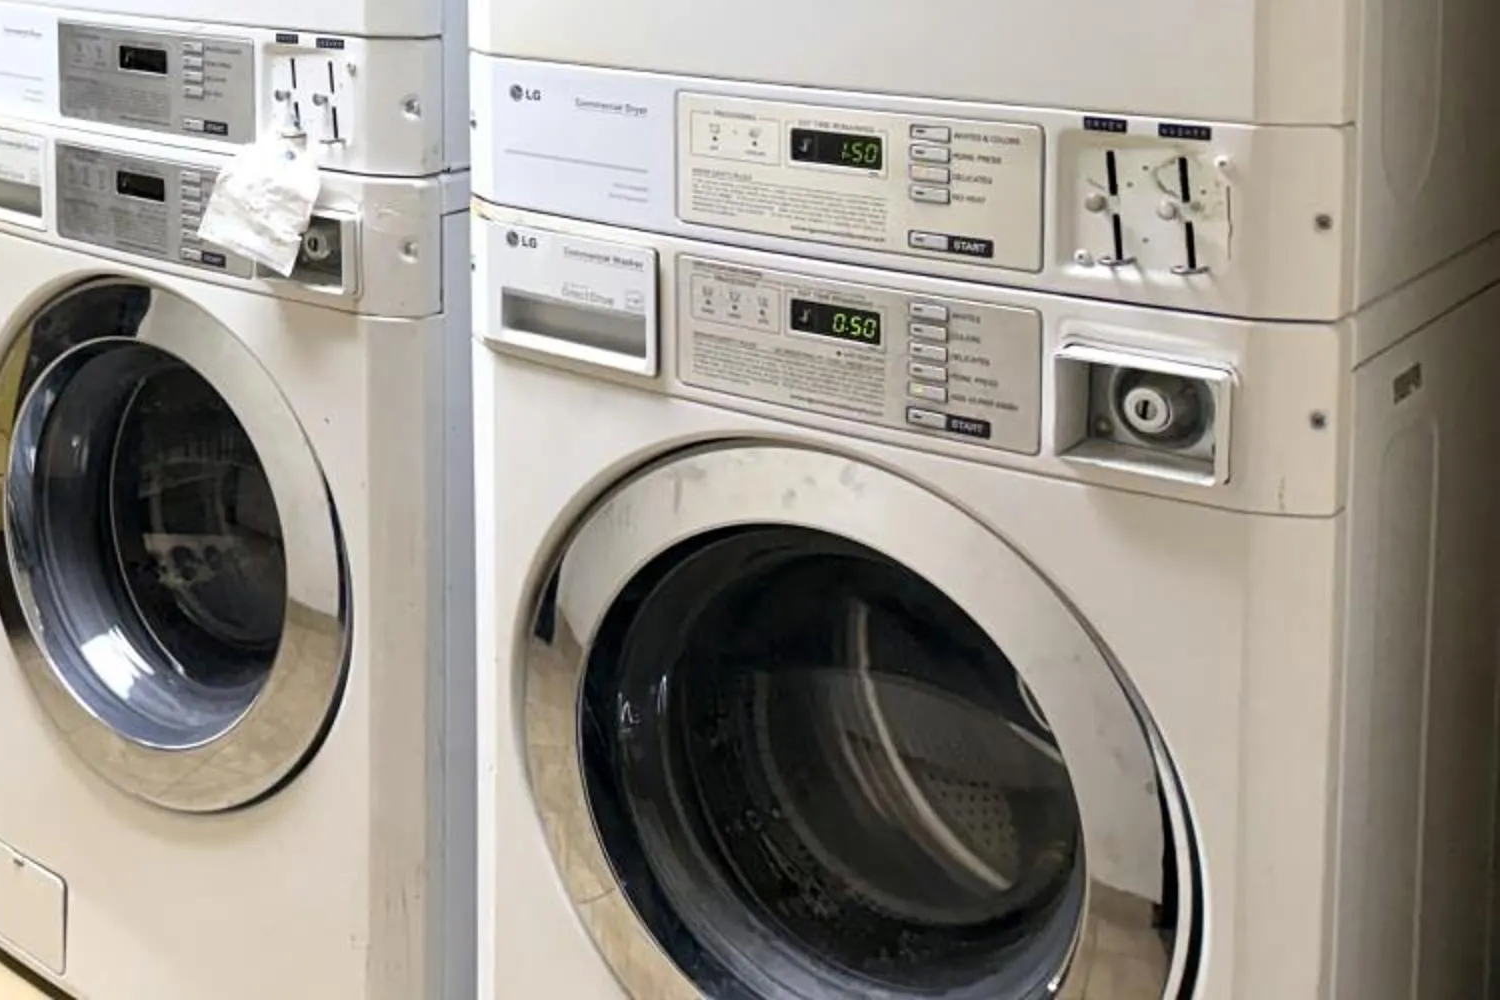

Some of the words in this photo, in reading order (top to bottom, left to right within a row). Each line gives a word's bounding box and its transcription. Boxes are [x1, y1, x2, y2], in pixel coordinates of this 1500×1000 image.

[525, 88, 542, 101] LG
[521, 235, 538, 249] LG
[953, 240, 987, 255] START
[951, 418, 983, 434] START
